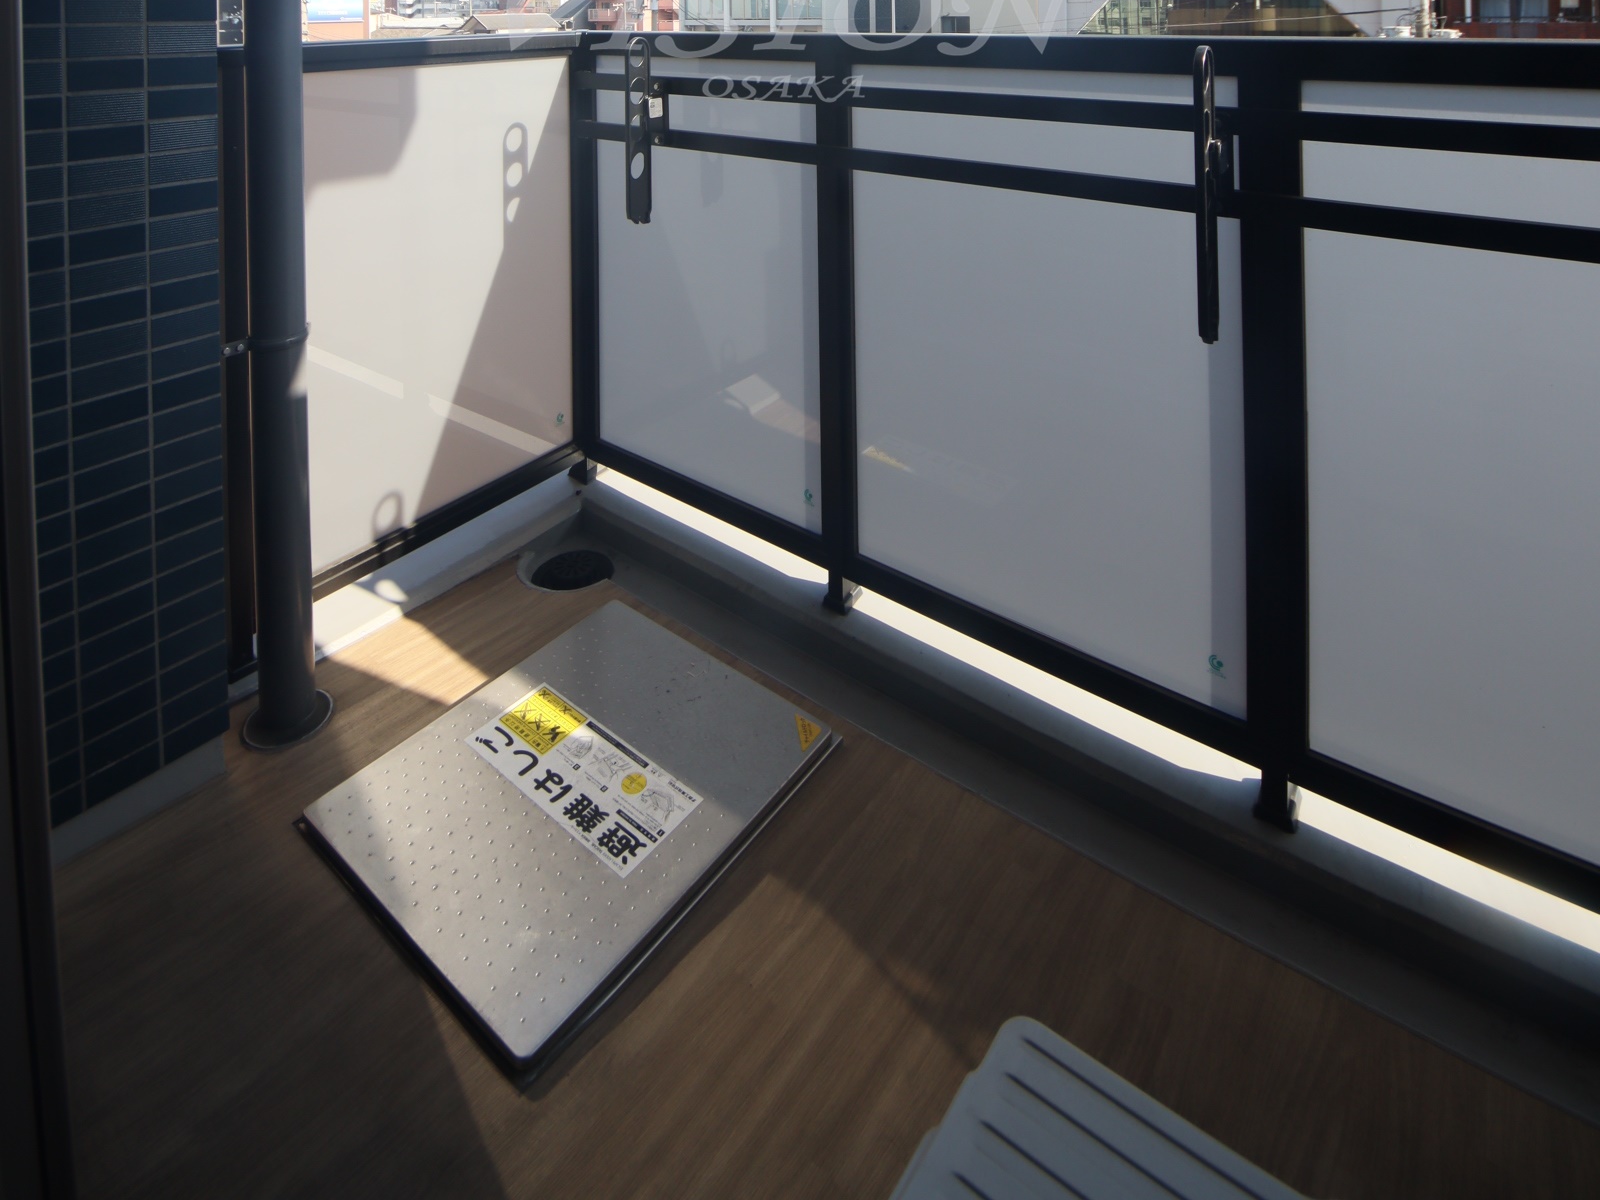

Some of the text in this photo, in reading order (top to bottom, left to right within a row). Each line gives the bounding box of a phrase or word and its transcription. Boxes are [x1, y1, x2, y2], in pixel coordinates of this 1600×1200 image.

[474, 725, 648, 865] 避難はしご
